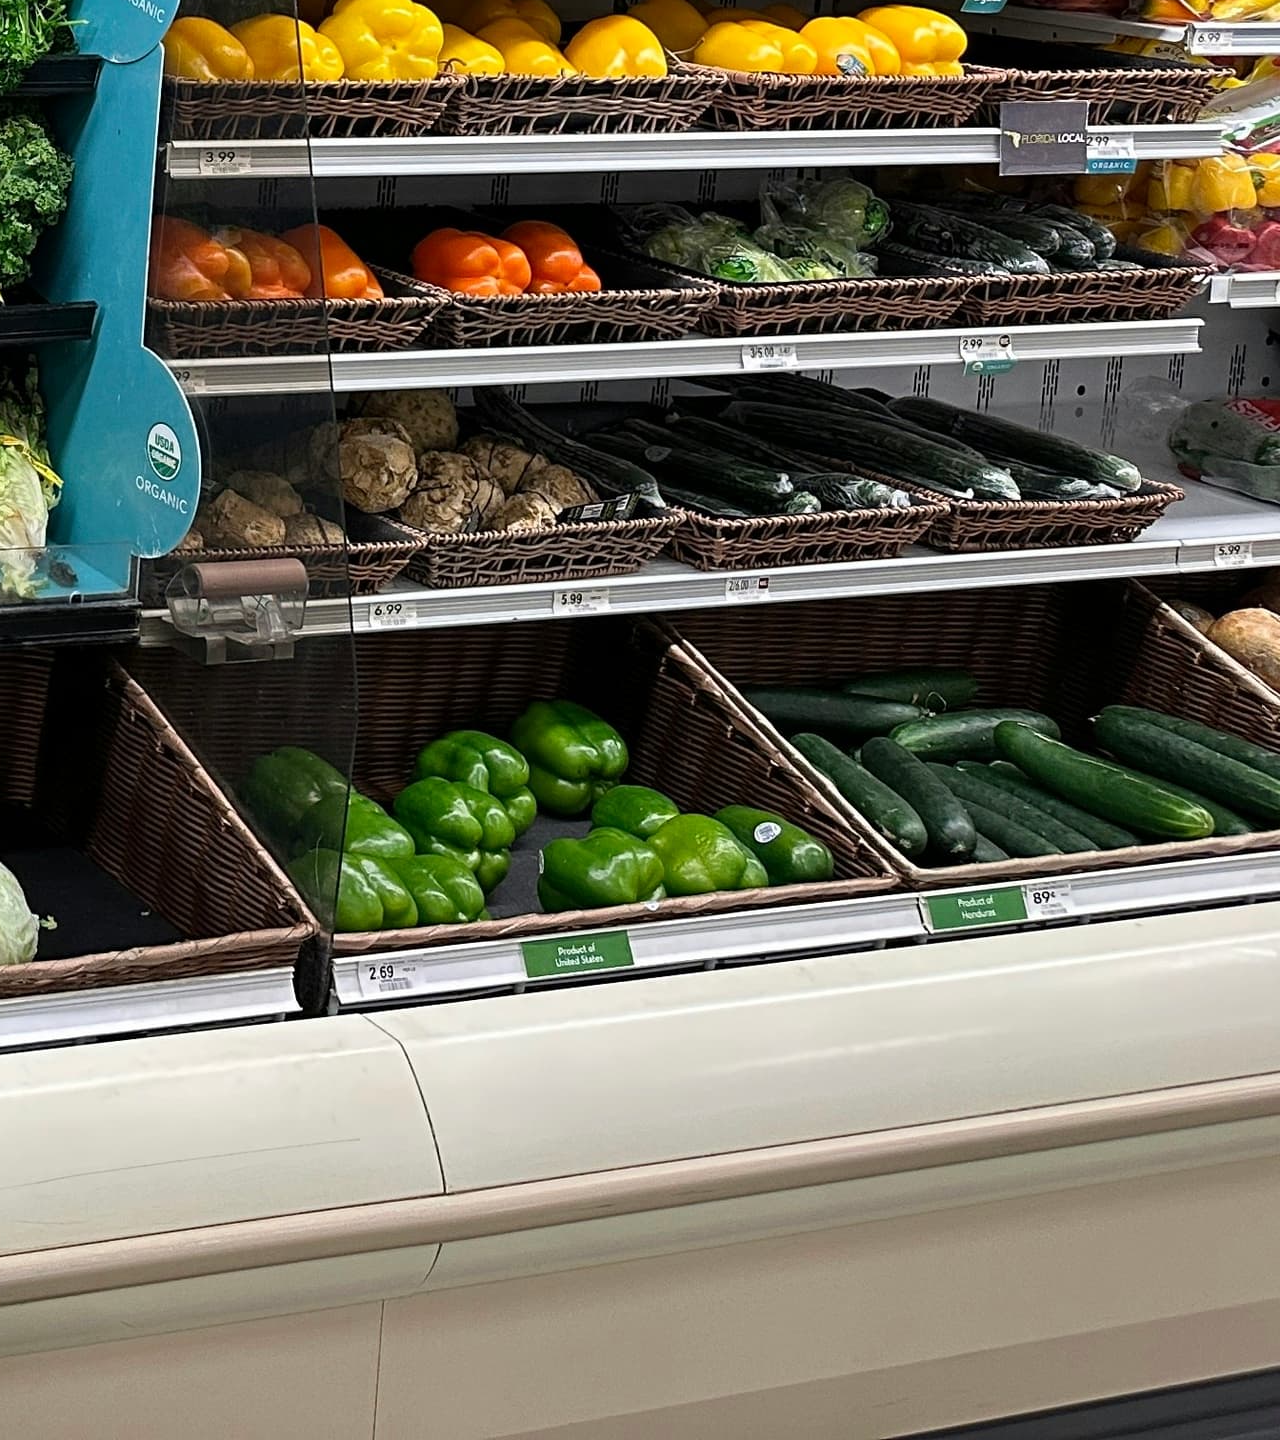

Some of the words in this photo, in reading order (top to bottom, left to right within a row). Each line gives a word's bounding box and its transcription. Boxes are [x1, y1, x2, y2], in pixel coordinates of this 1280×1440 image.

[1197, 31, 1221, 43] 6.99
[1021, 133, 1056, 144] FLORIDA
[1057, 133, 1086, 144] LOCAL
[1092, 161, 1130, 169] ORGANIC
[154, 433, 175, 454] USDA
[135, 475, 188, 514] ORGANIC
[1218, 544, 1241, 556] 5.99
[560, 593, 583, 606] 5.99
[374, 603, 402, 616] 6.99
[957, 897, 985, 907] Product
[986, 895, 994, 905] of
[961, 908, 997, 920] Honduras
[557, 945, 586, 956] Product
[586, 942, 596, 953] of
[554, 957, 580, 969] United
[580, 954, 604, 965] States
[368, 964, 394, 980] 2.69
